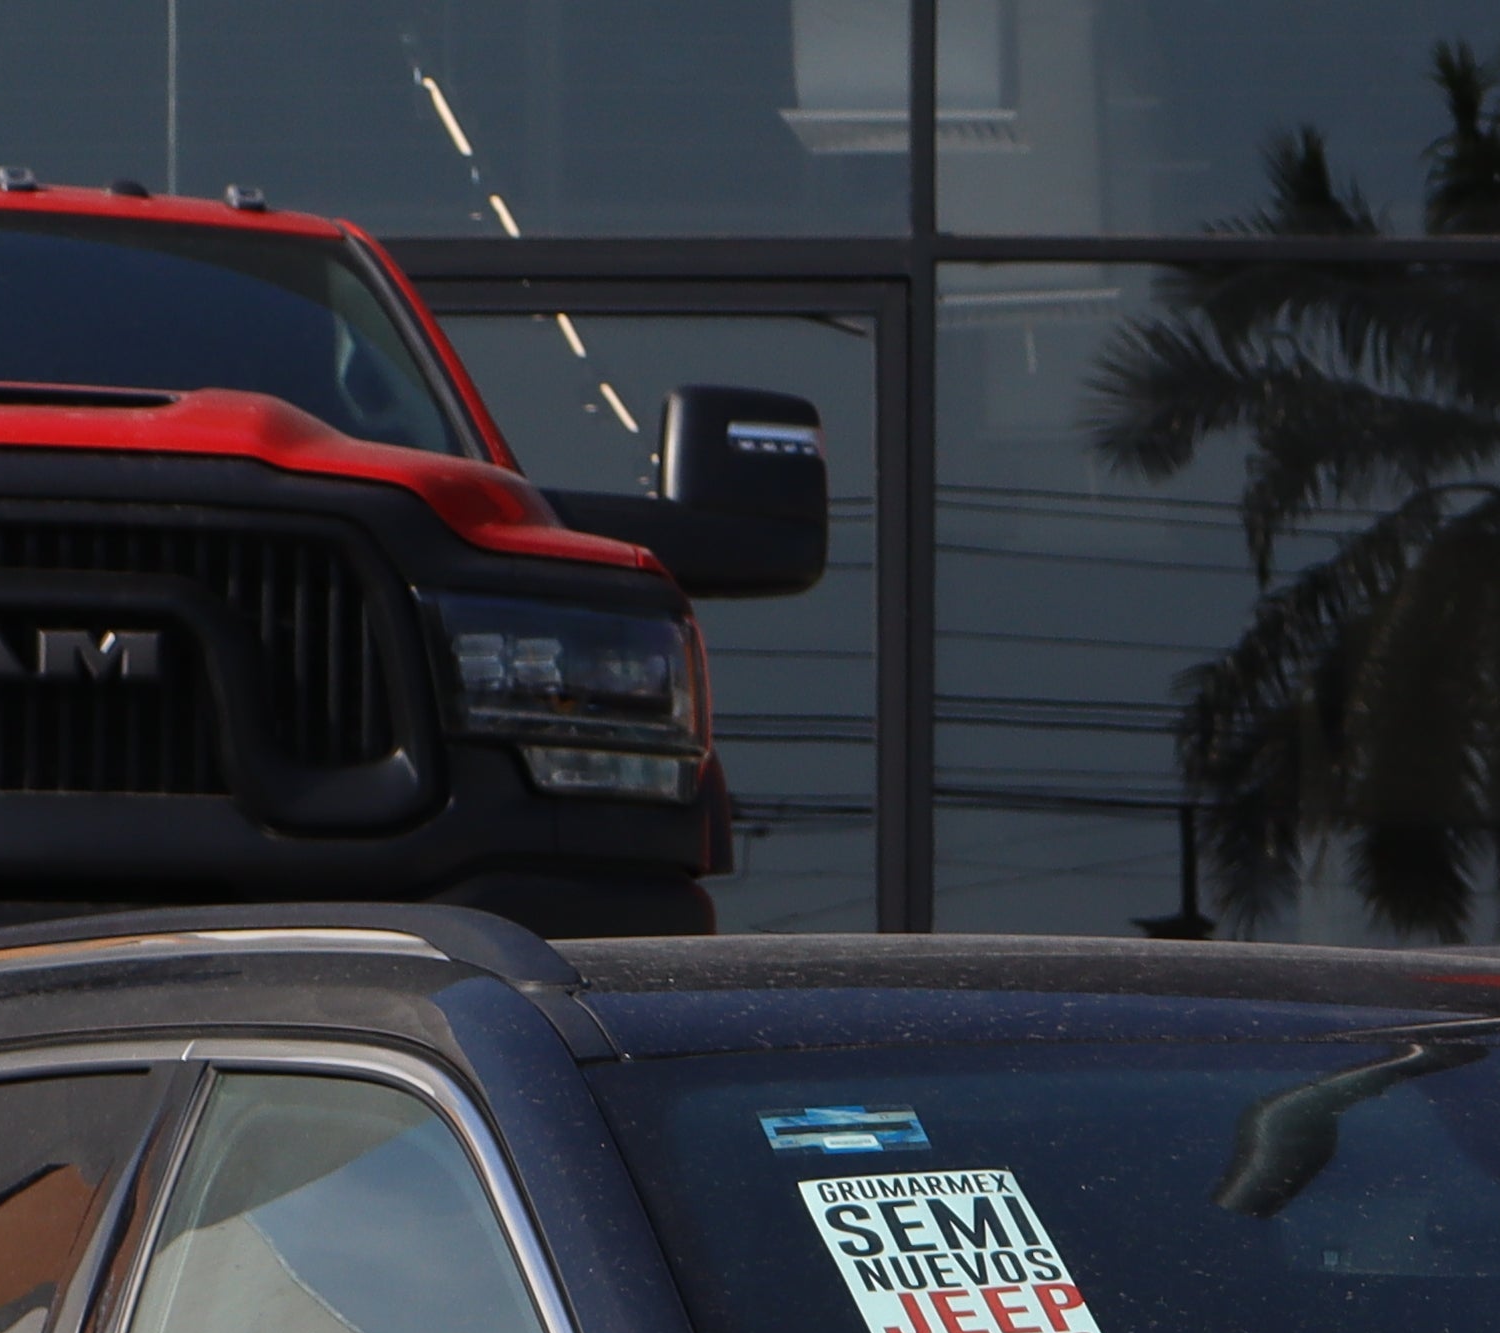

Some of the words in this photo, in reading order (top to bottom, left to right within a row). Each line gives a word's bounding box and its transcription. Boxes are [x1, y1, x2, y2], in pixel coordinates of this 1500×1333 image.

[817, 1173, 1012, 1203] GRUMARMEX
[826, 1195, 1041, 1257] SEMI
[853, 1249, 1062, 1291] NUEVOS
